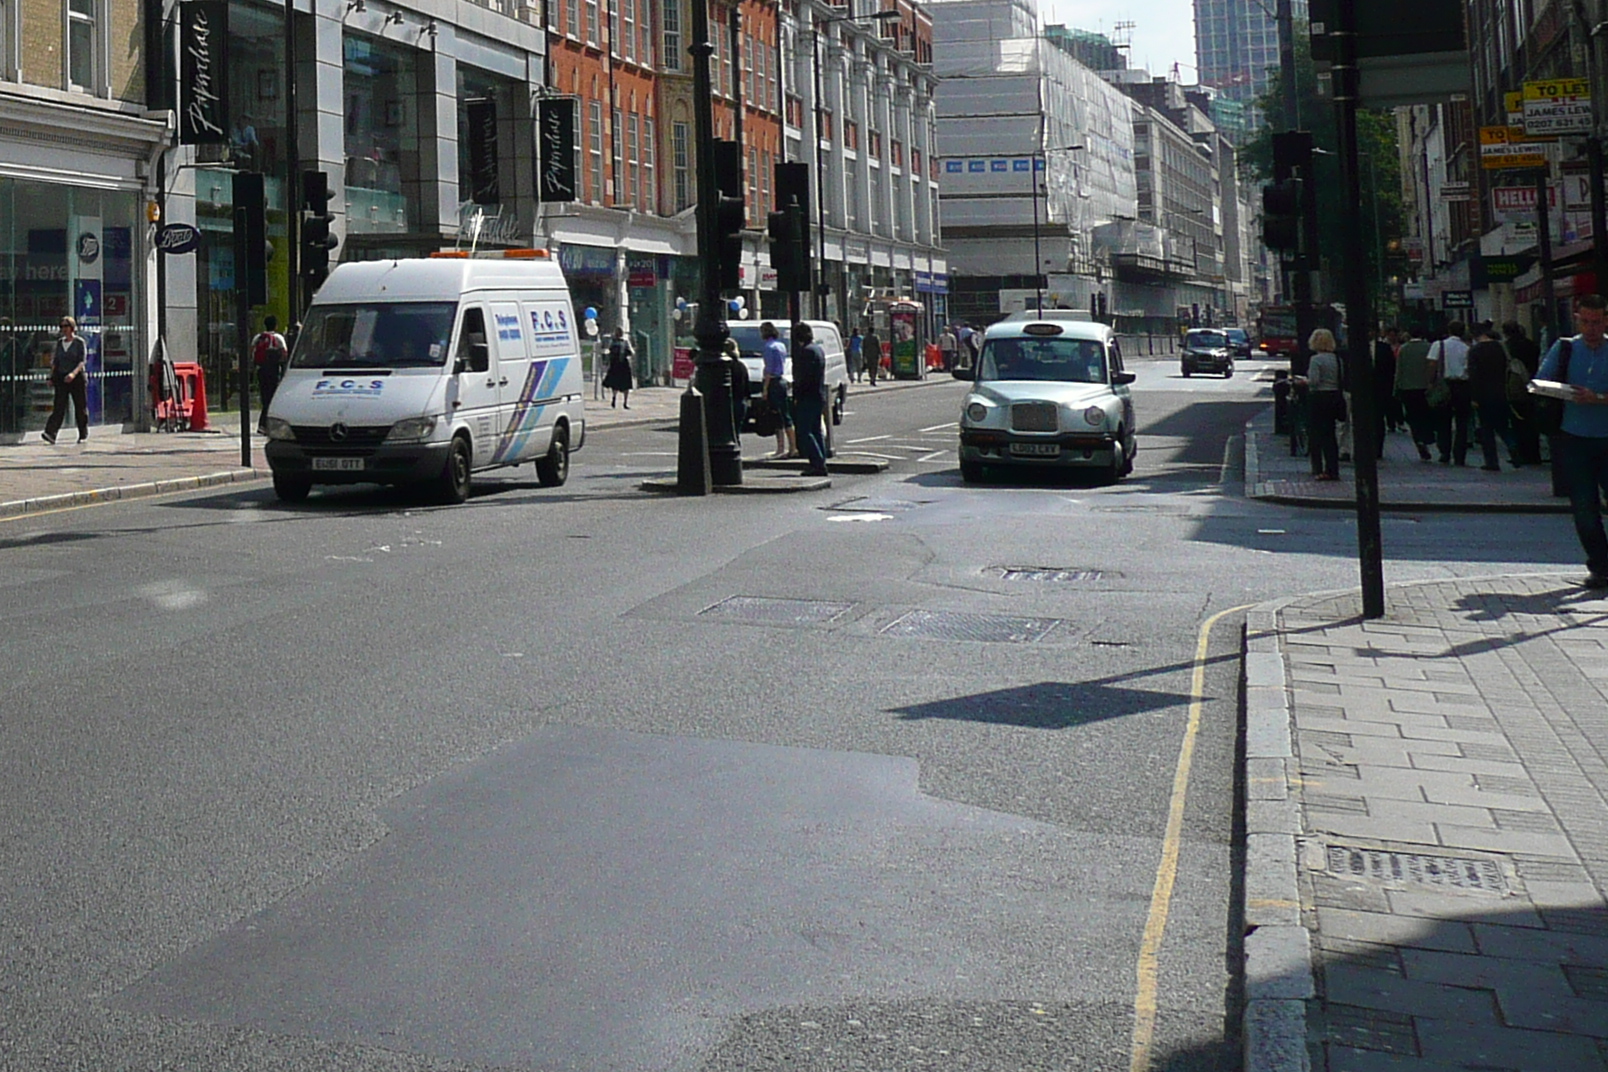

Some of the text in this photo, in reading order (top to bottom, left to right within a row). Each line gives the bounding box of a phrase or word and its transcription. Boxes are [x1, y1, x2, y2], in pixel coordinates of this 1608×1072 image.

[1537, 85, 1557, 96] TO
[1527, 108, 1565, 117] JAMES
[25, 260, 69, 280] here
